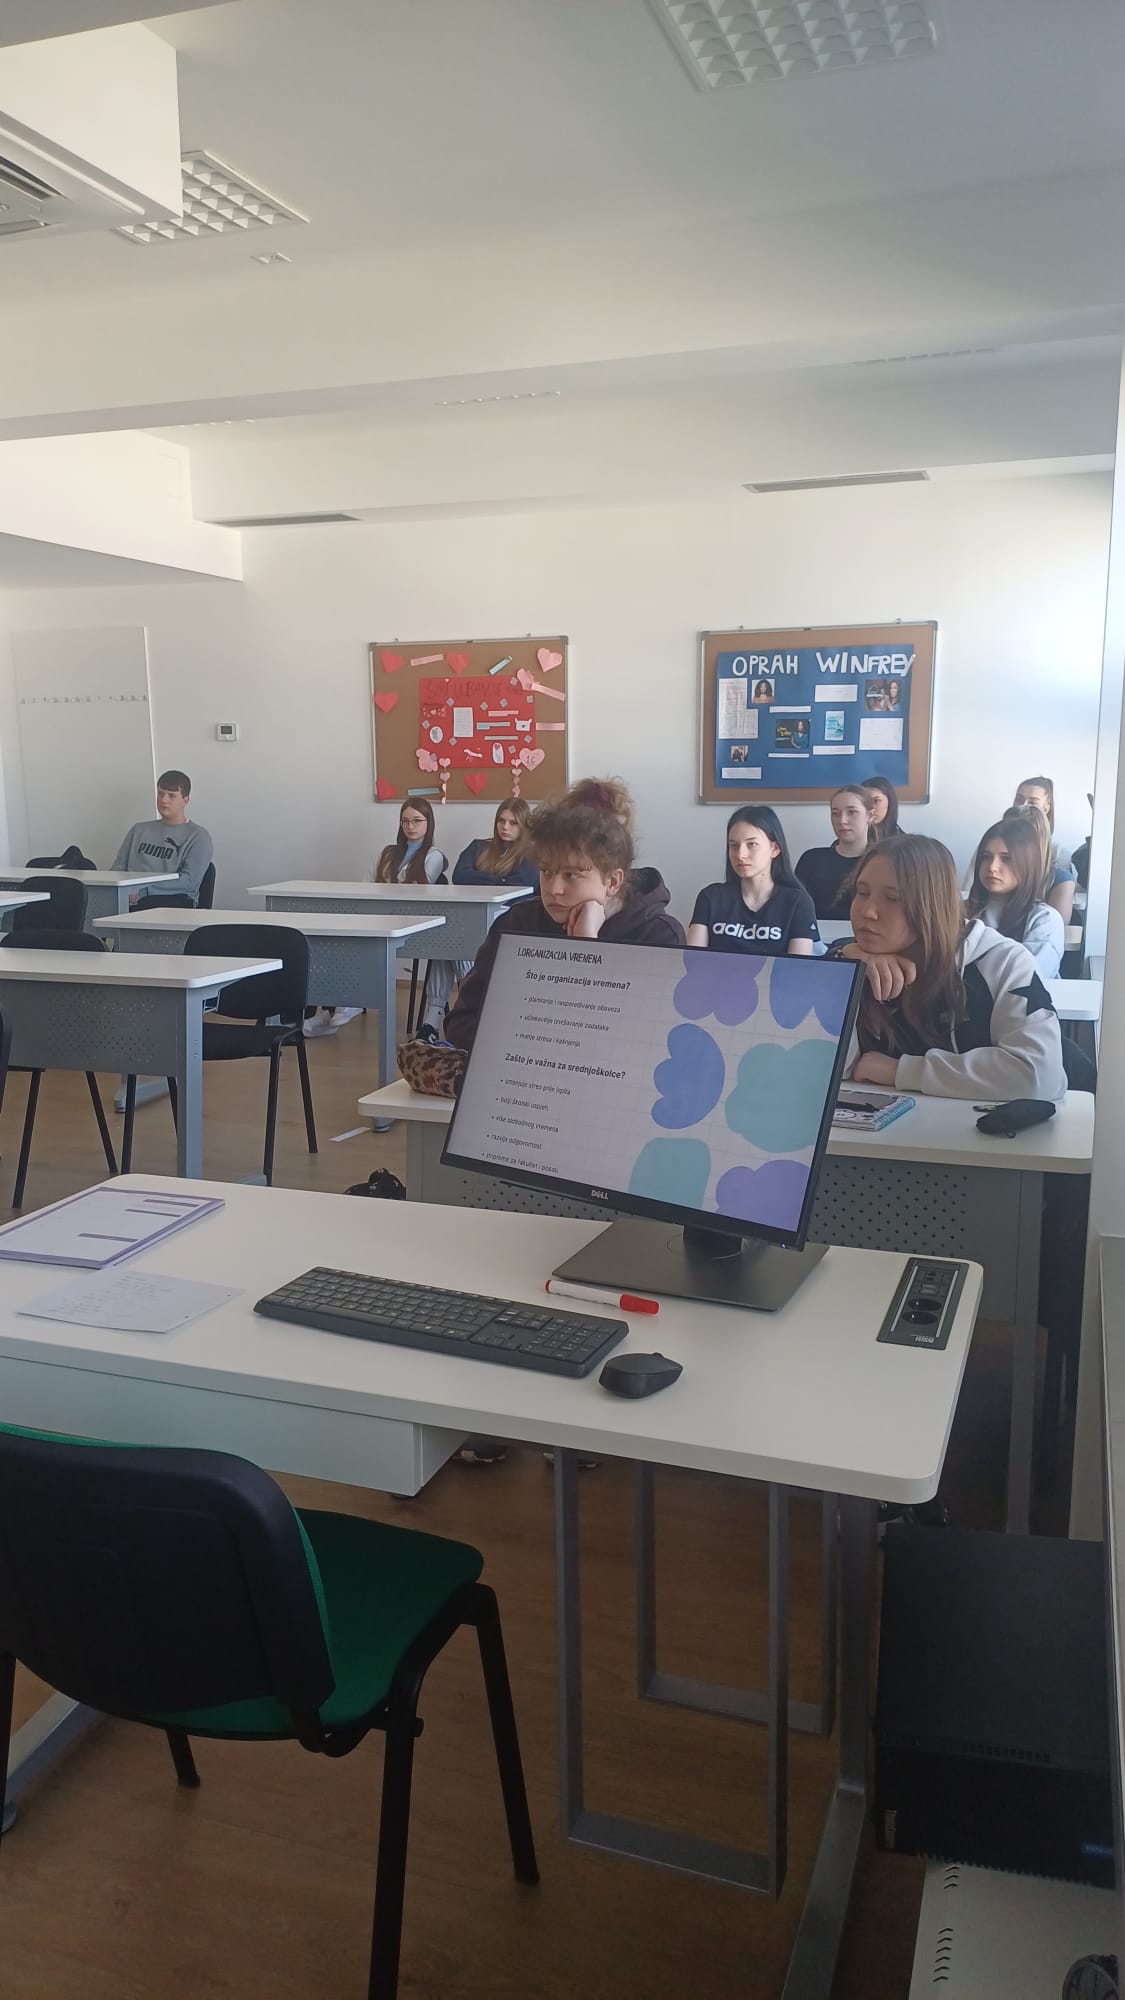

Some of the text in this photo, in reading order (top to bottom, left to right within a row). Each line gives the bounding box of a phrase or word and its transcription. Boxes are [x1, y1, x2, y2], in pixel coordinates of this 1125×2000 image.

[732, 651, 917, 678] OPRAH WINFREY
[138, 842, 174, 860] PUMA
[712, 922, 782, 940] adidas
[569, 952, 602, 965] VREMENA
[525, 969, 631, 990] Što je organizacija vremena?
[505, 1053, 626, 1080] Zašto je važna za srednjoškolce?
[591, 1189, 609, 1200] DELL
